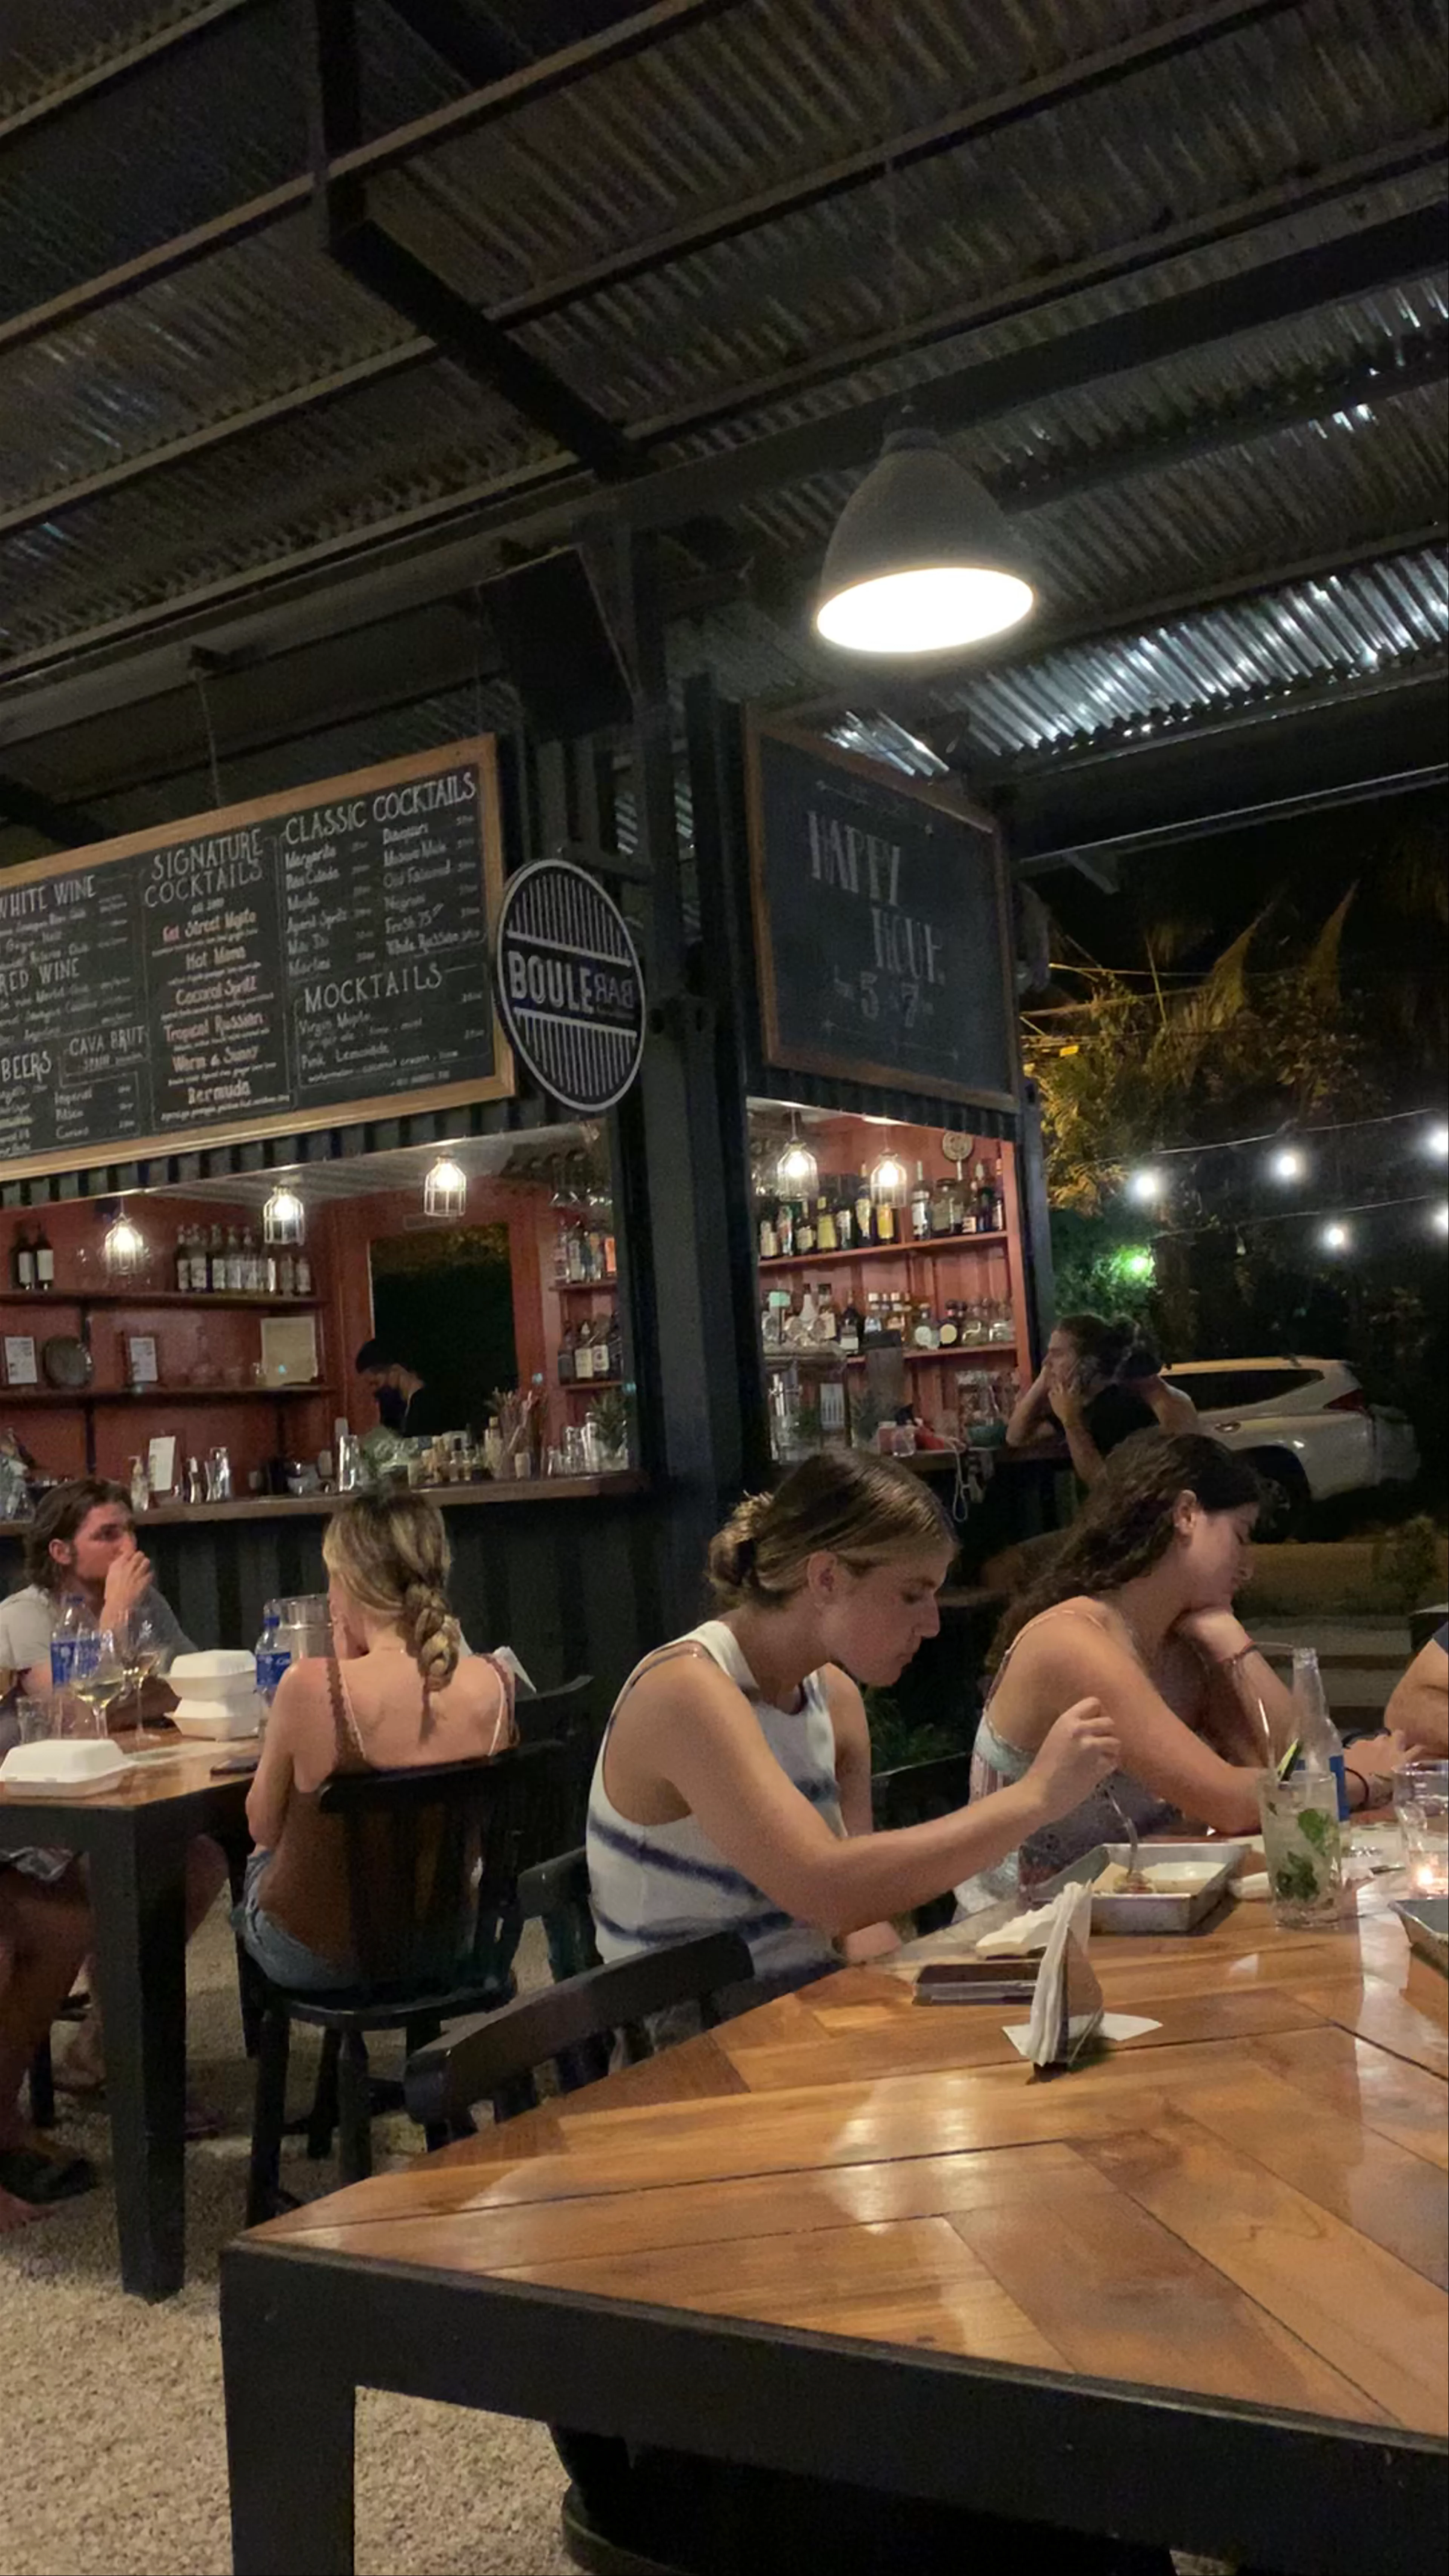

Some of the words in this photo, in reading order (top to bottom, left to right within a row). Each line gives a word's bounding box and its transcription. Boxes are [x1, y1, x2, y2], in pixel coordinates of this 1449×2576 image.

[286, 801, 366, 845] CLASSIC
[373, 772, 476, 821] COCKTAILS
[152, 828, 263, 881] SIGNATURE
[54, 874, 96, 906] WINE
[145, 858, 263, 907] COCKTAILS
[0, 970, 29, 997] RED
[38, 958, 80, 984] WINE
[304, 962, 443, 1013] MOCKTAILS
[508, 950, 594, 1014] BOULE
[69, 1034, 105, 1056] CAVA
[111, 1026, 145, 1052] BRUT
[1, 1051, 52, 1083] BEERS
[188, 1079, 251, 1105] Bermuda
